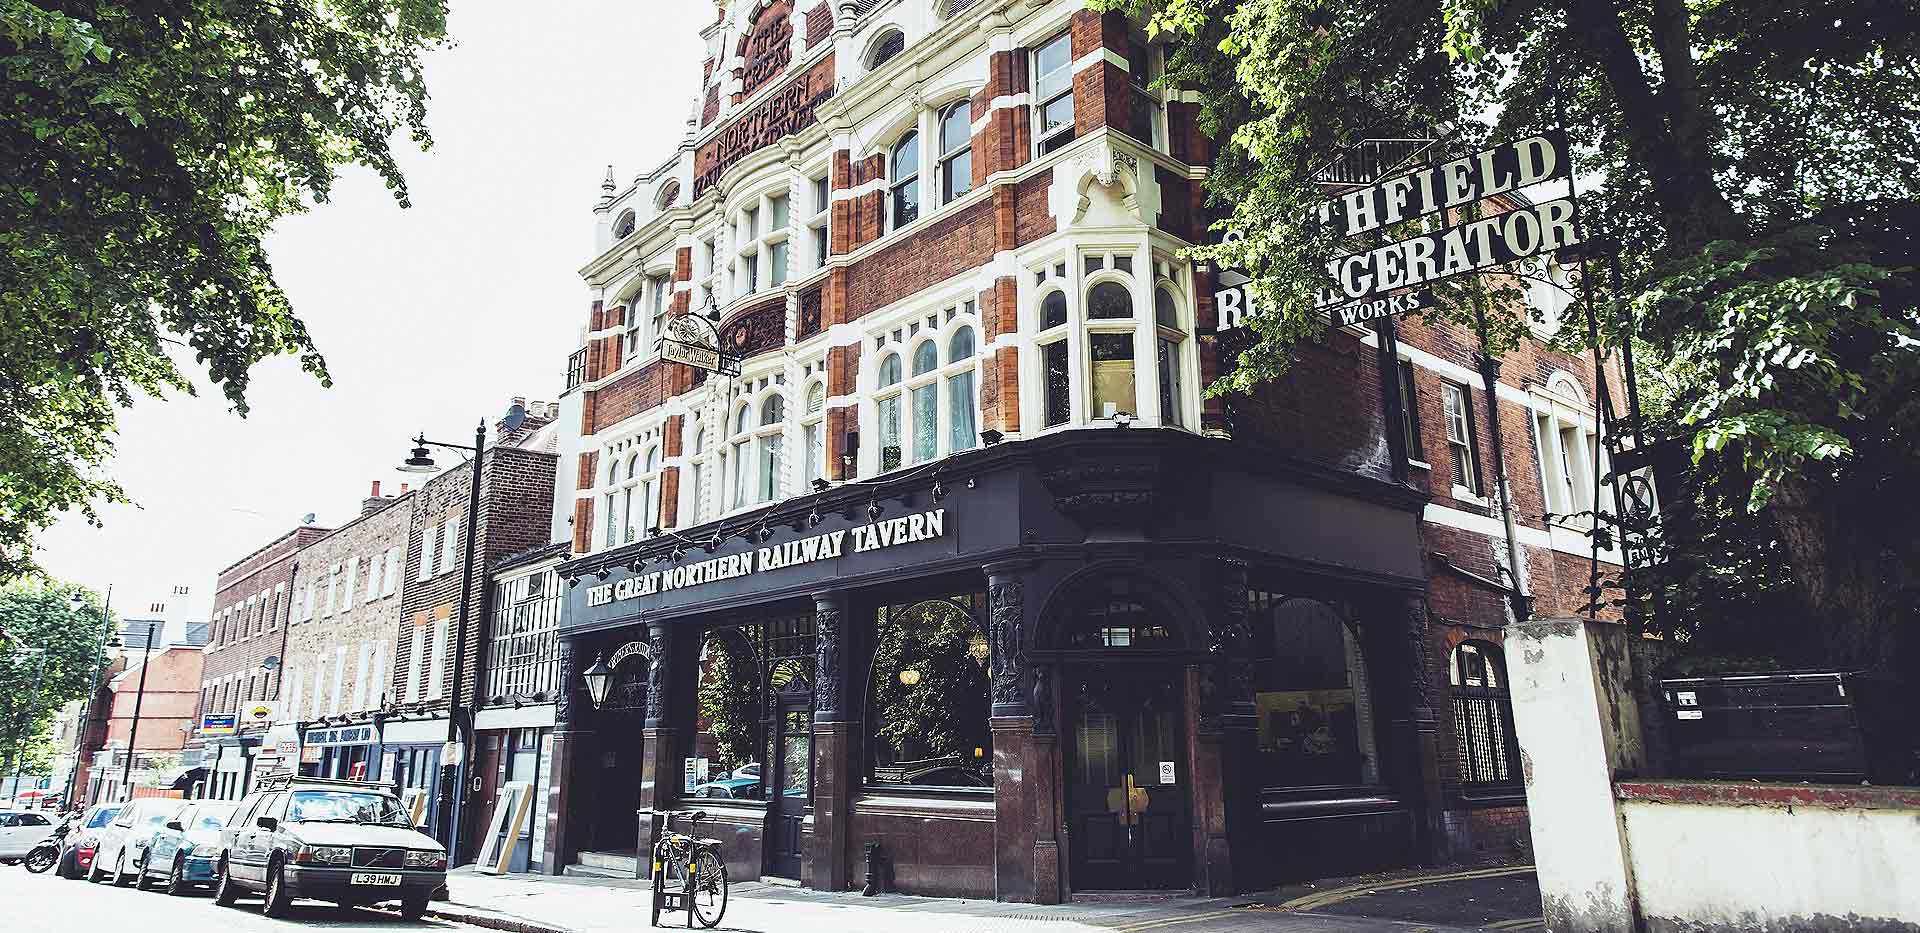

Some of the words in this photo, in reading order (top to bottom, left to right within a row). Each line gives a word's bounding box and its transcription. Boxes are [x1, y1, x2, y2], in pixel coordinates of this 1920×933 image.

[715, 73, 809, 163] NORTHERN
[1215, 199, 1580, 332] REIGERATOR
[1339, 290, 1420, 325] WORKS
[689, 346, 716, 366] Walker
[586, 585, 612, 607] THE
[614, 573, 662, 601] GREAT
[661, 551, 753, 592] NORTHERN
[757, 529, 846, 572] RAILWAY
[851, 509, 945, 552] TAVERN
[356, 874, 377, 884] L39
[377, 874, 398, 885] HMJ
